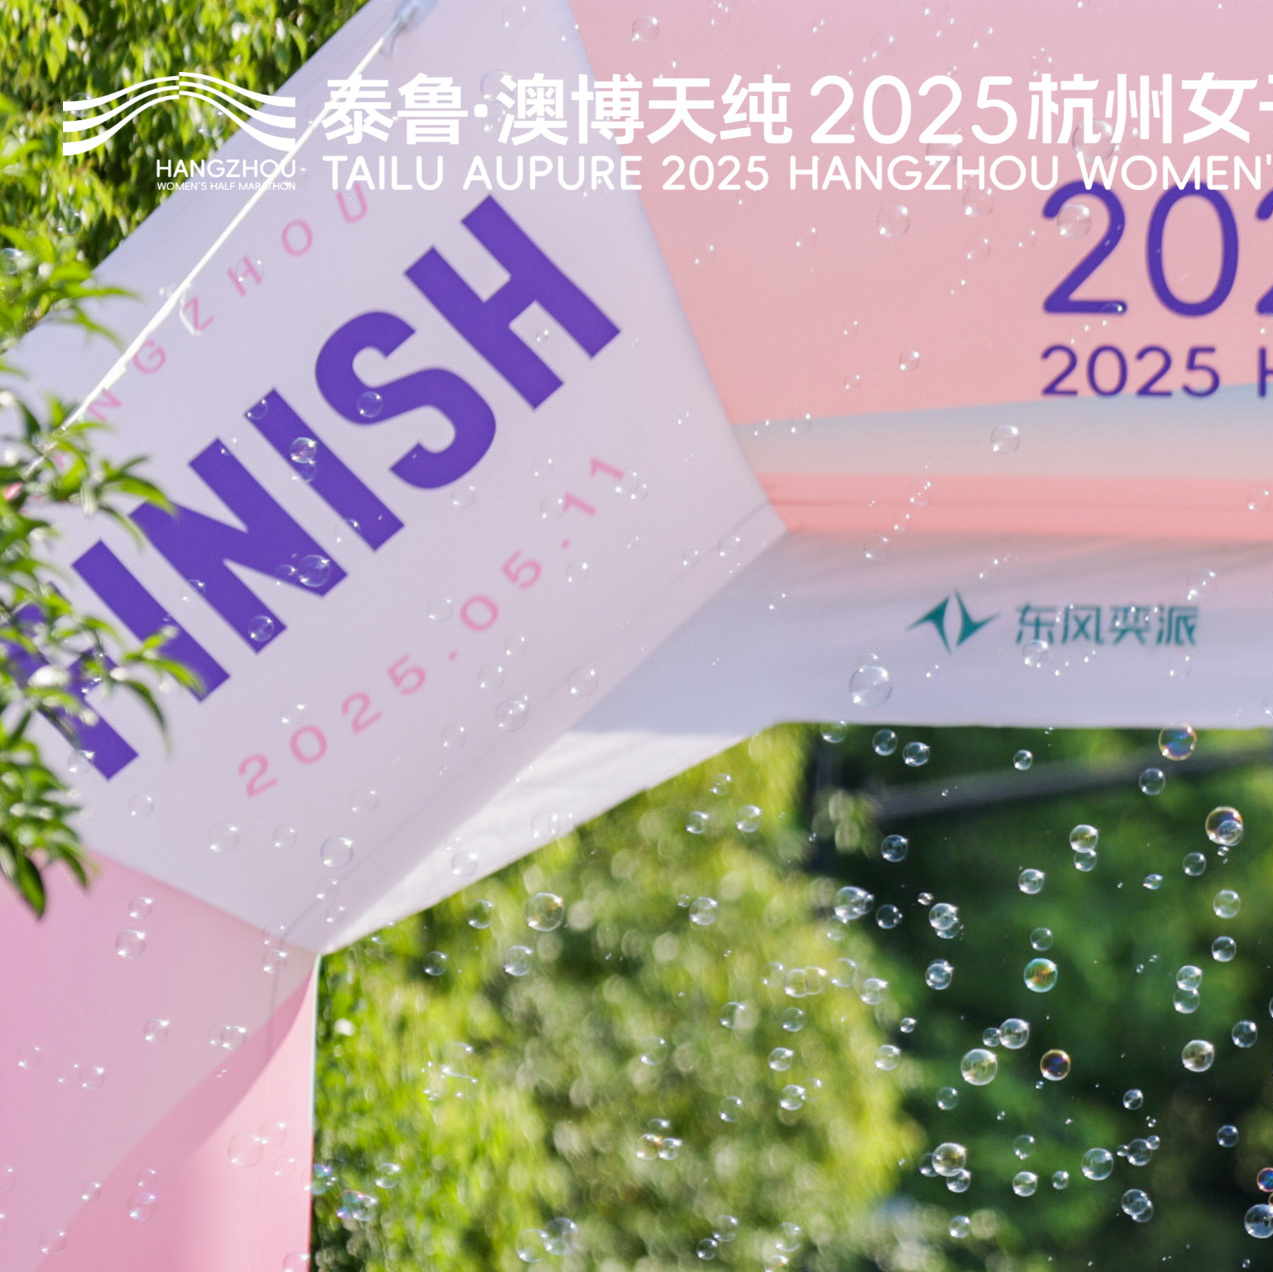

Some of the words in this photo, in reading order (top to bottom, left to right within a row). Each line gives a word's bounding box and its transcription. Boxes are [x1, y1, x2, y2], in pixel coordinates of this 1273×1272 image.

[1041, 345, 1221, 398] 2025
[238, 456, 625, 798] 2025.05.11
[1015, 603, 1199, 646] 东风奕派
